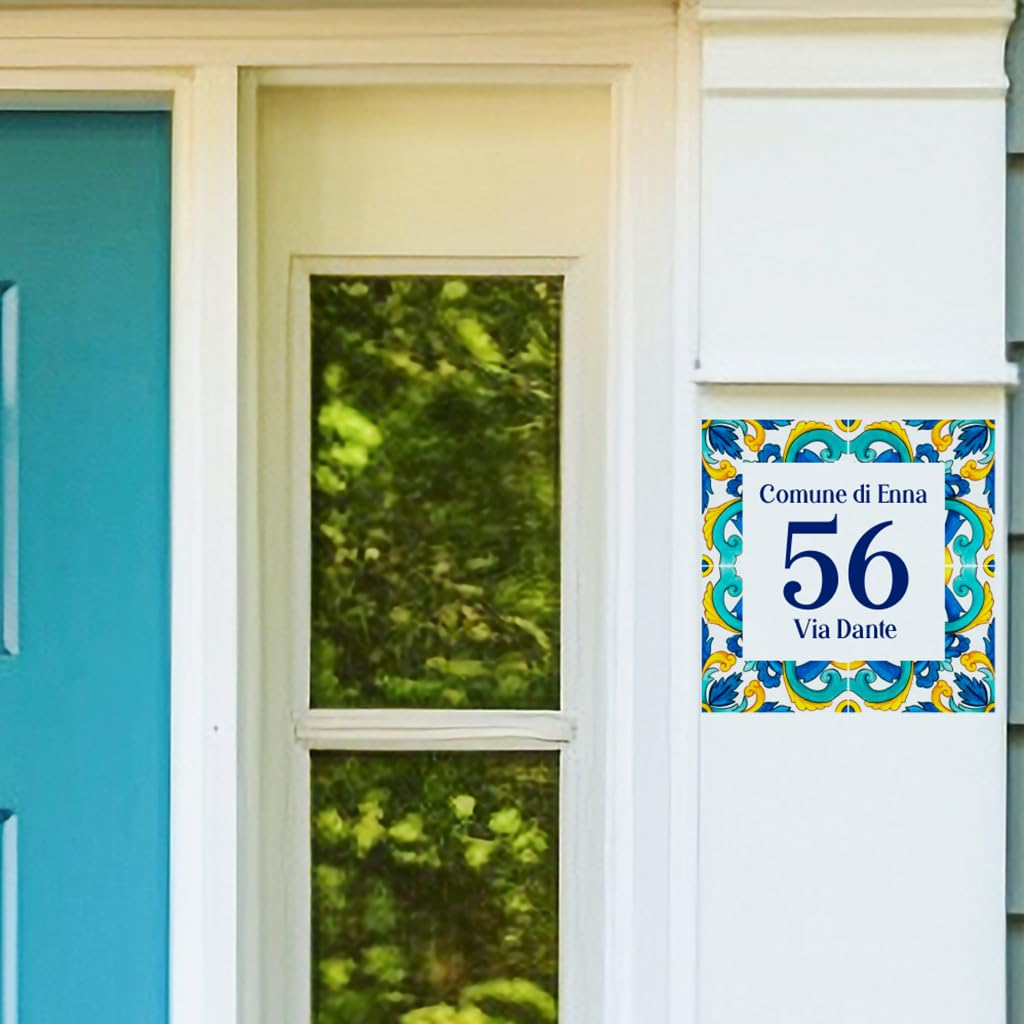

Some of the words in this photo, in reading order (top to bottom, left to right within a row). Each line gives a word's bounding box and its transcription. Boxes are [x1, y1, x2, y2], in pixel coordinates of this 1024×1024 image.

[759, 483, 847, 504] Comune
[852, 483, 871, 504] di
[878, 483, 928, 504] Enna
[782, 513, 909, 611] 56
[793, 618, 831, 640] Via
[837, 618, 897, 640] Dante
